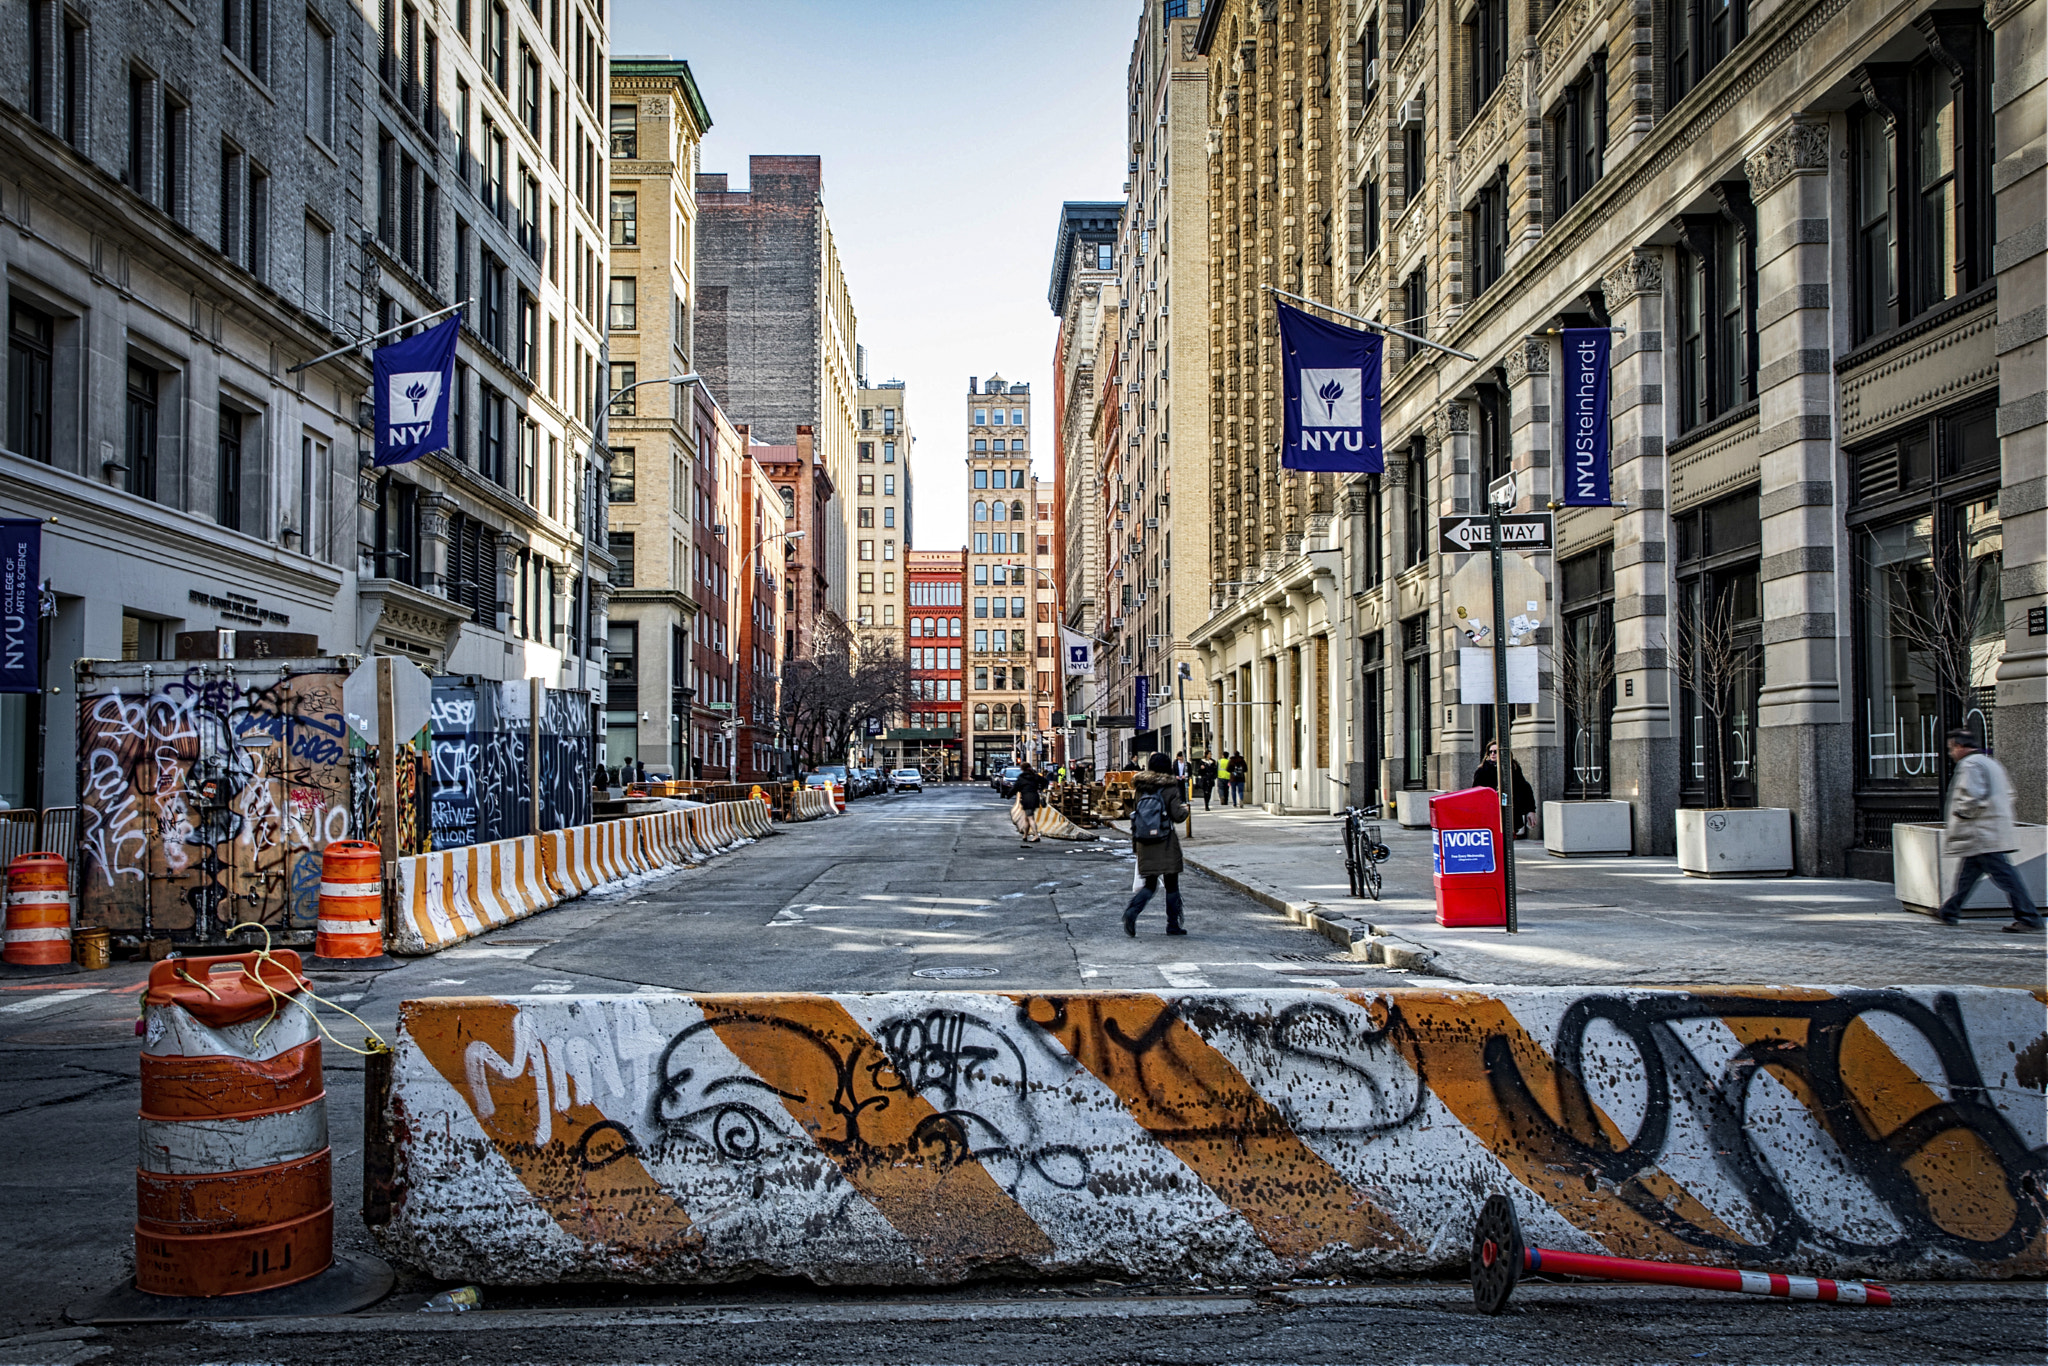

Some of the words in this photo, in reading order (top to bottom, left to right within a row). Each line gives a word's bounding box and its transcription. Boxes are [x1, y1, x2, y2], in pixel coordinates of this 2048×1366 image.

[1576, 340, 1596, 497] NYUSteinhardt
[1301, 430, 1363, 452] NYU
[1460, 528, 1492, 541] ONE
[1502, 525, 1537, 540] WAY
[6, 557, 15, 571] OF
[17, 542, 28, 581] SCIENCE
[5, 571, 15, 614] COLLEGE
[17, 581, 26, 590] &
[16, 591, 26, 614] ARTS
[4, 616, 25, 669] NYU
[1447, 832, 1490, 847] VOICE
